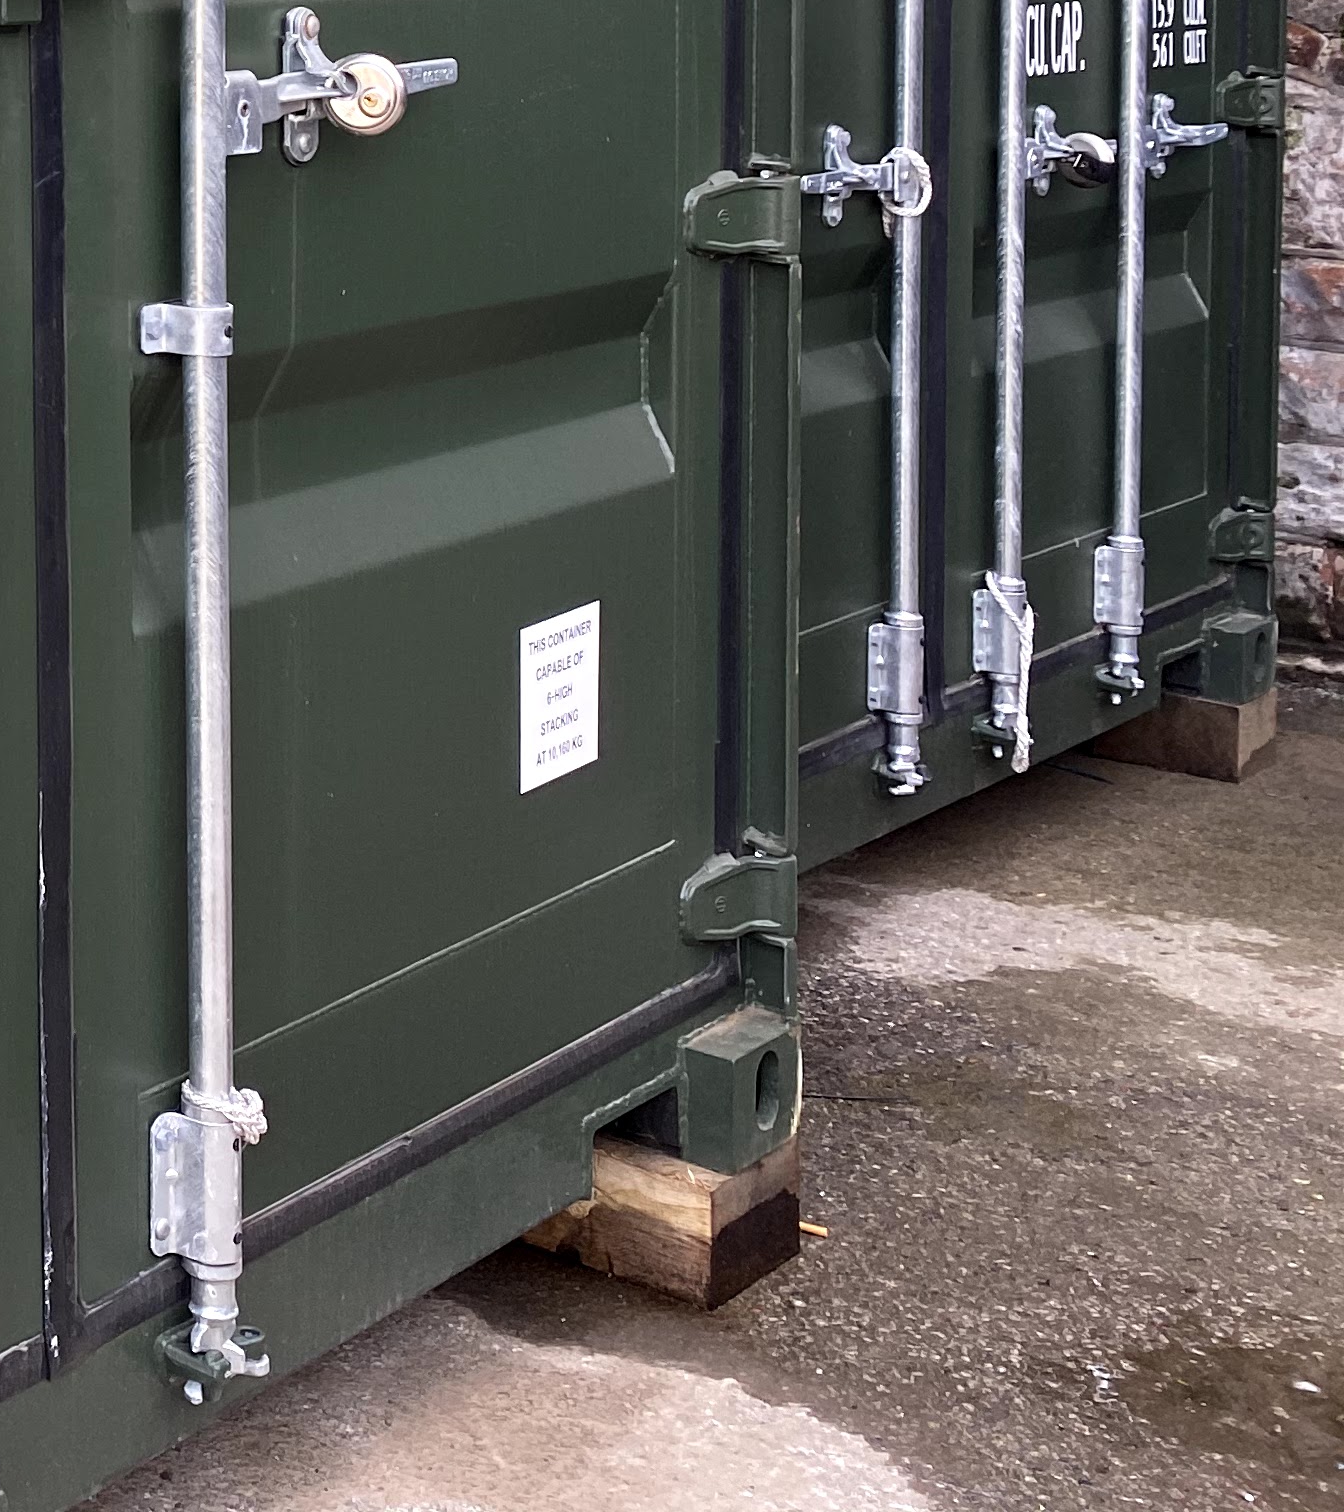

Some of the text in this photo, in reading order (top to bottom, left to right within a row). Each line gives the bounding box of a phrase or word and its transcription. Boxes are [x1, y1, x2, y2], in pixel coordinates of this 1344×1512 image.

[1152, 32, 1174, 68] 561
[528, 620, 591, 655] THIS CONTAINER
[535, 651, 583, 681] CAPABLE OF
[540, 709, 578, 736] STACKING
[535, 751, 546, 766] AT
[571, 735, 582, 750] KG
